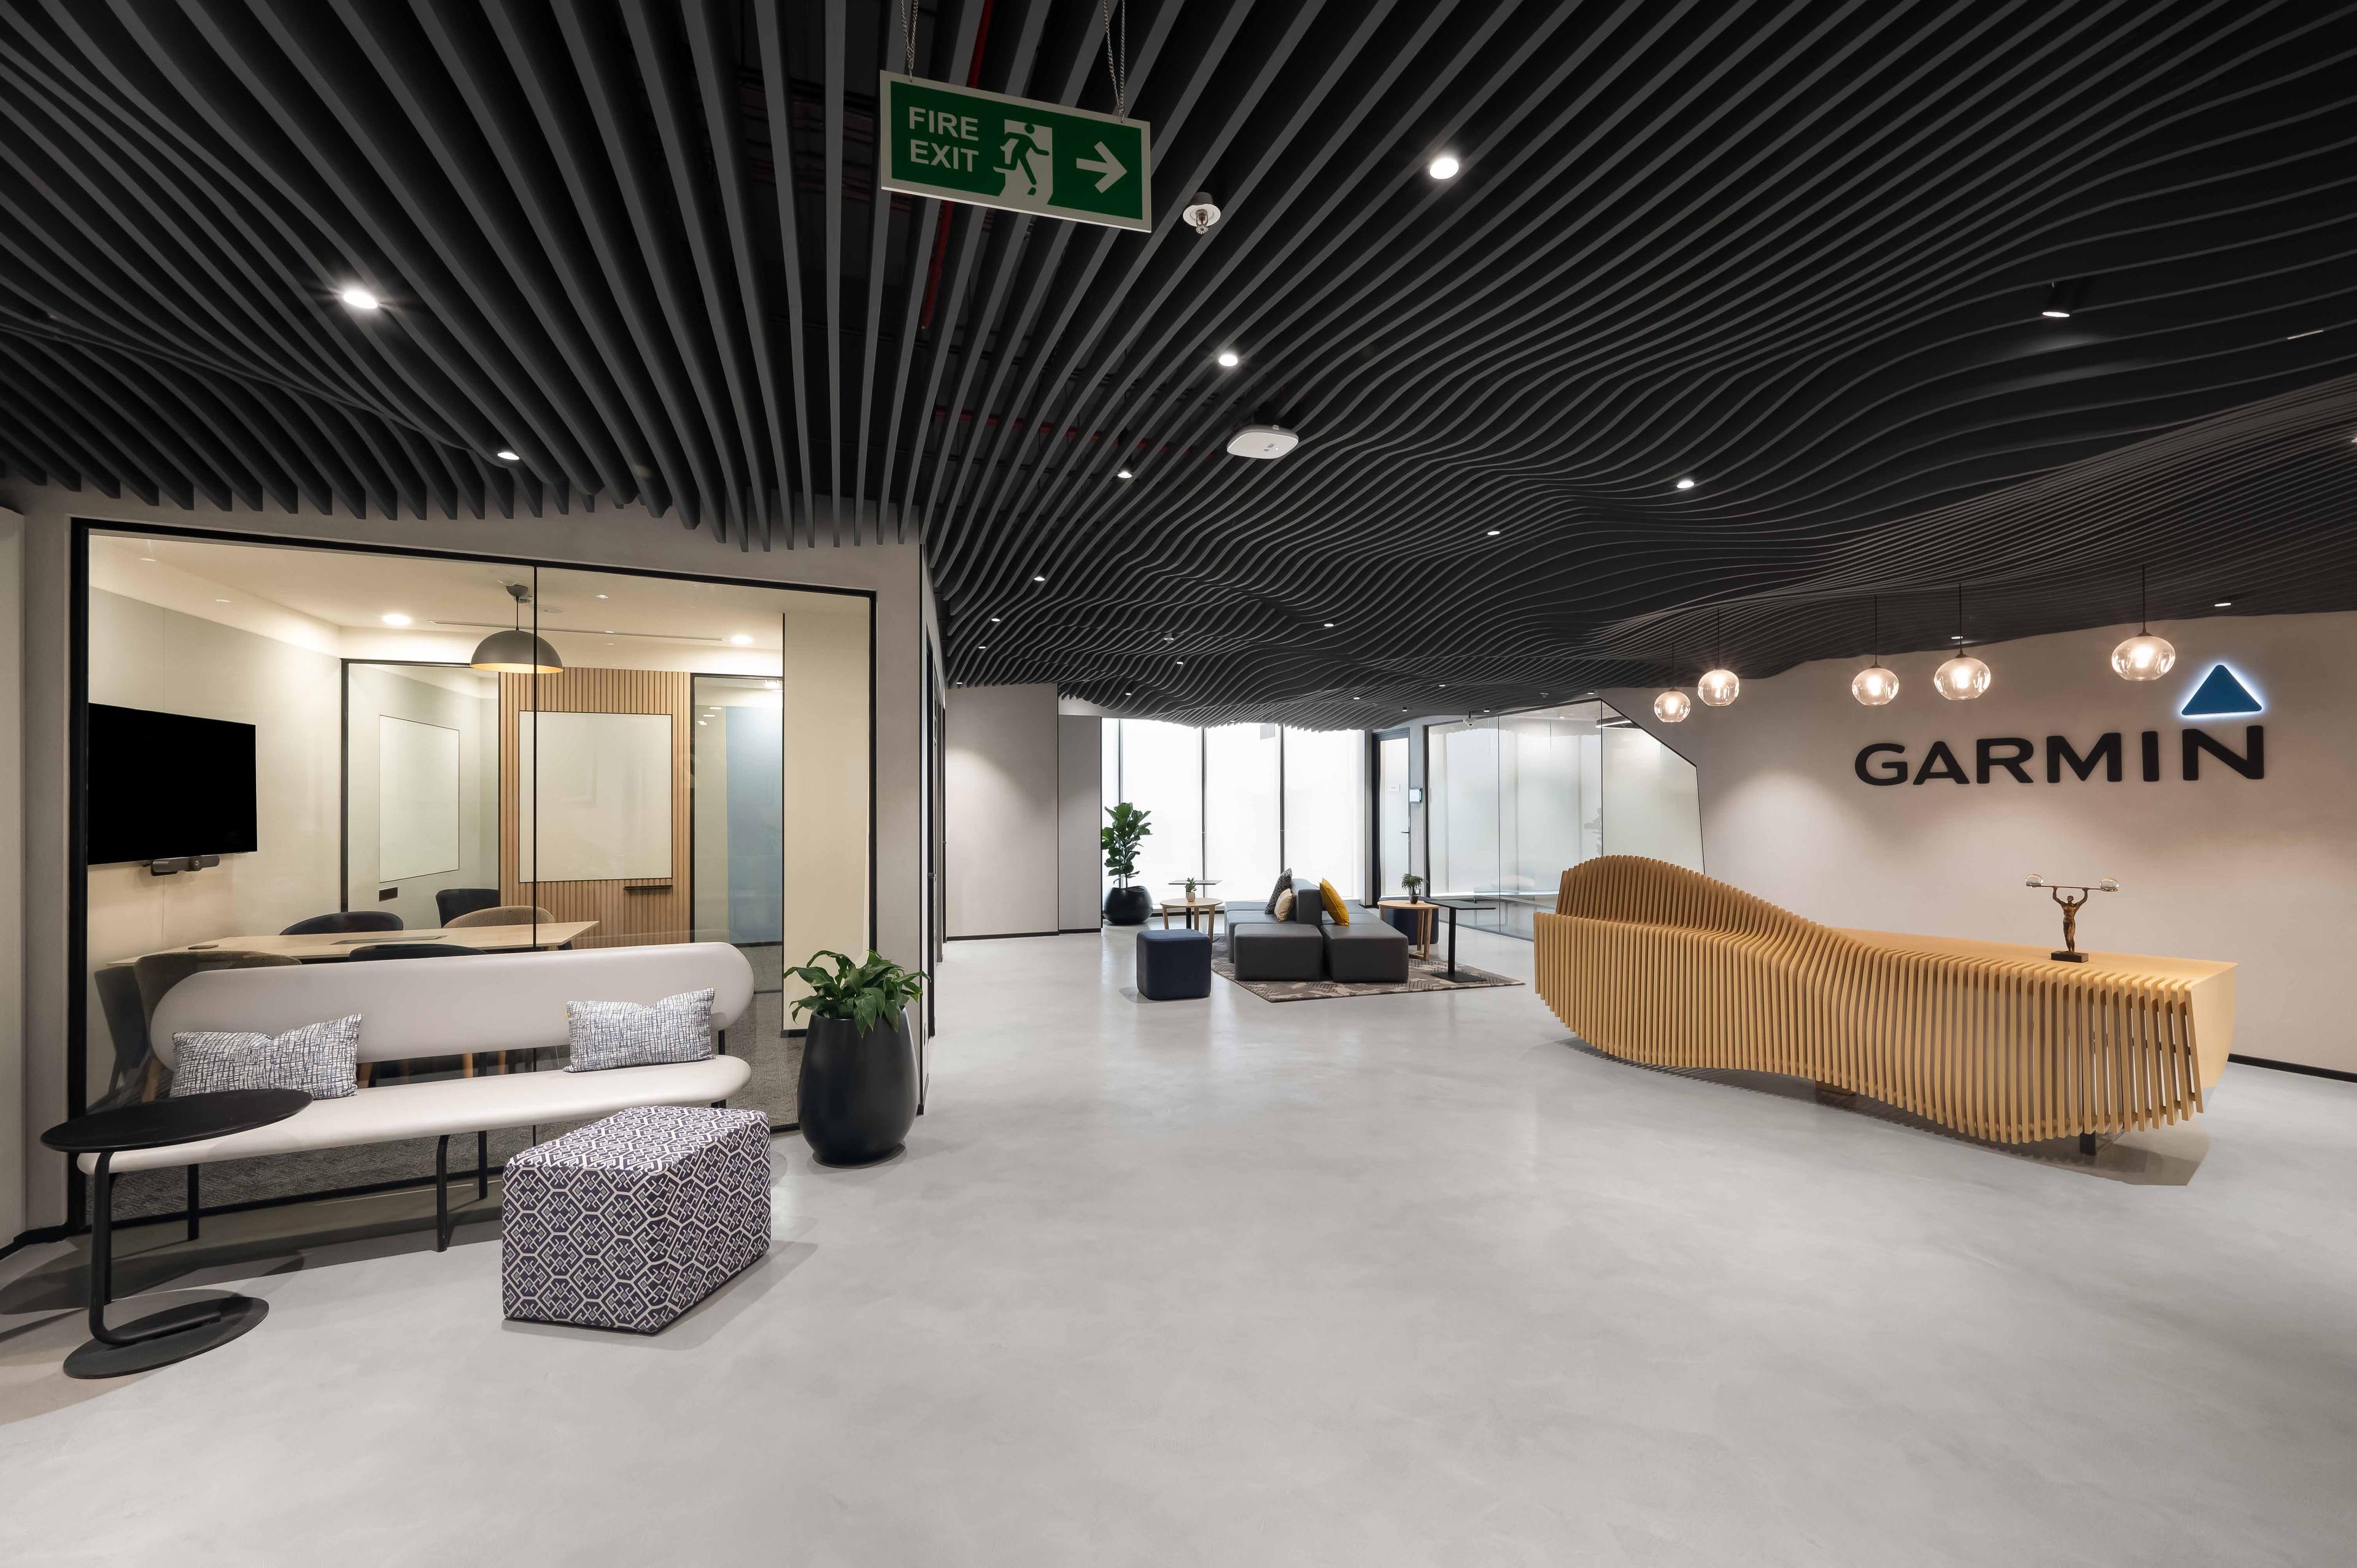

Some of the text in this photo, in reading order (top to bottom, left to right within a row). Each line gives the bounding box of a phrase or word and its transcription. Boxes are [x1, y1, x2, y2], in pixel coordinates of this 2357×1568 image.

[909, 106, 979, 141] FIRE
[910, 139, 979, 172] EXIT
[1854, 725, 2265, 786] GARMIN
